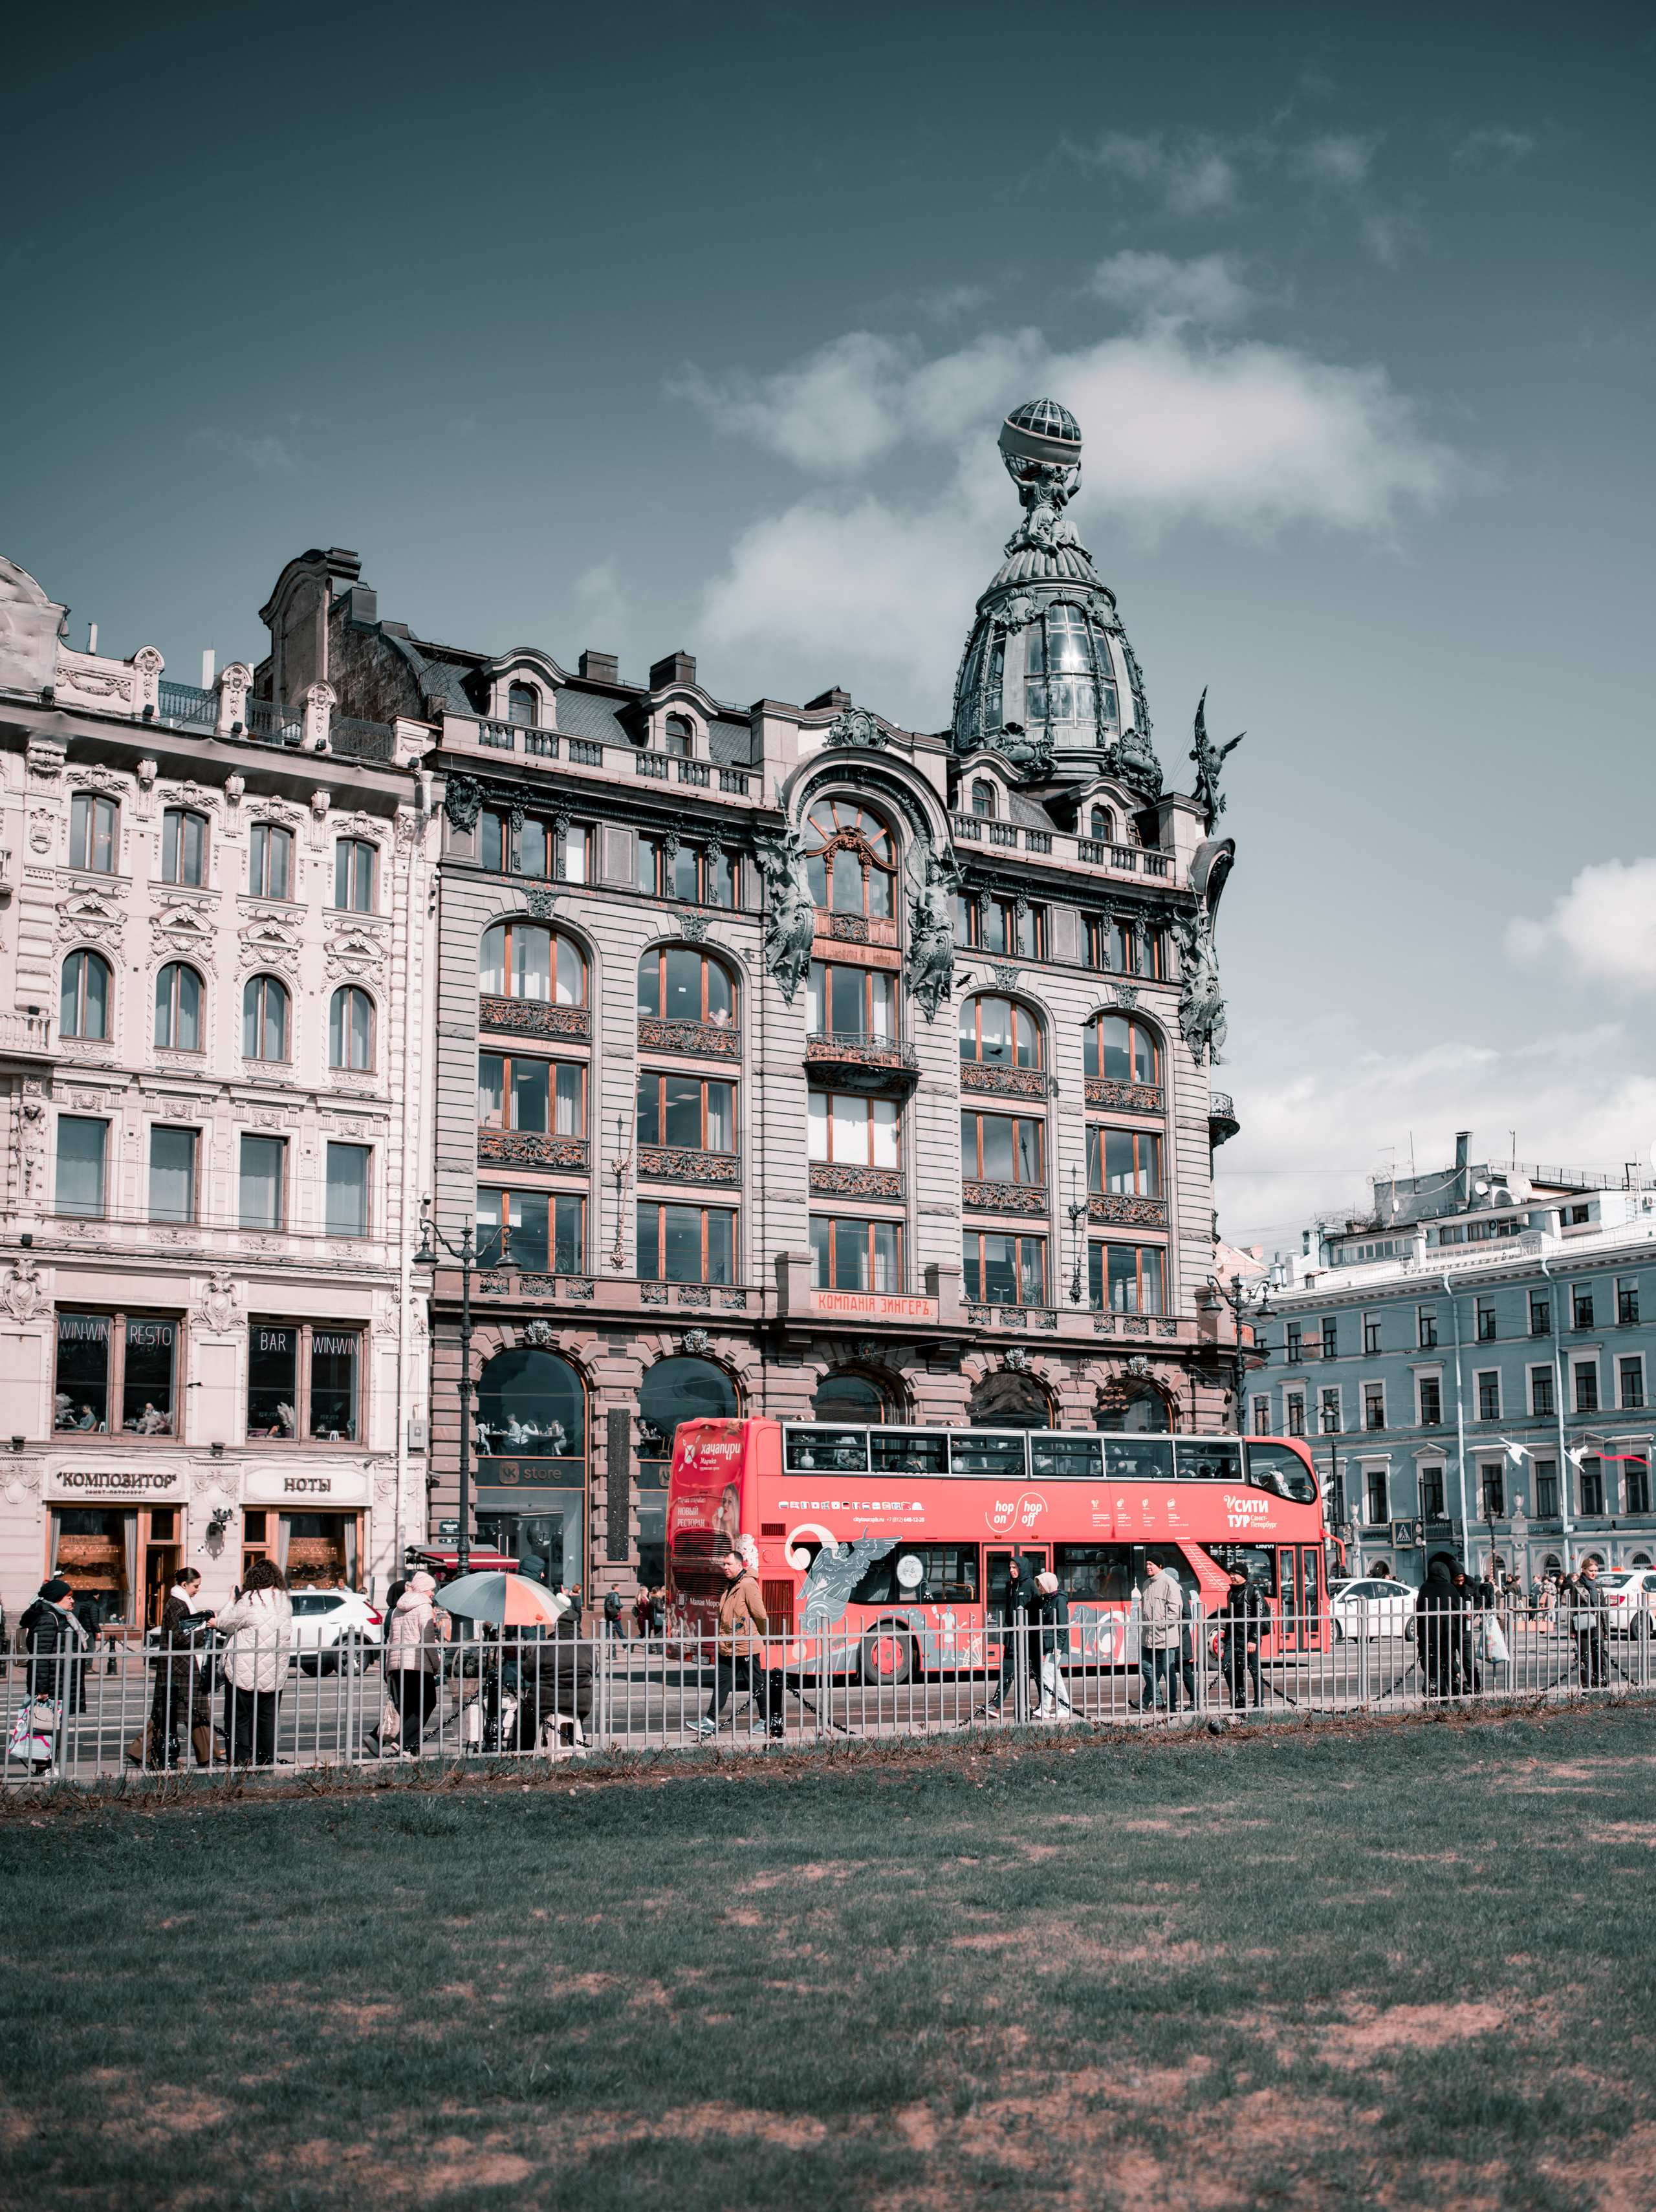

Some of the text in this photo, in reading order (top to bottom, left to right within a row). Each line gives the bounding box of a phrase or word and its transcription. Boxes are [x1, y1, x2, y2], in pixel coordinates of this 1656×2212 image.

[58, 1321, 172, 1346] WIN-WIN RESTO
[261, 1332, 358, 1355] BAR WIN-WIN
[701, 1443, 741, 1460] хачапури
[523, 1466, 562, 1480] store
[284, 1478, 332, 1492] НОТЫ
[677, 1506, 699, 1515] НОВЫЙ
[995, 1500, 1014, 1515] hop
[1023, 1500, 1043, 1515] hop
[1234, 1499, 1269, 1513] СИТИ
[677, 1518, 705, 1527] РЕСТОРАН
[994, 1515, 1007, 1524] on
[1021, 1512, 1036, 1527] off
[1227, 1514, 1250, 1528] ТУР
[1250, 1521, 1278, 1530] Петербург
